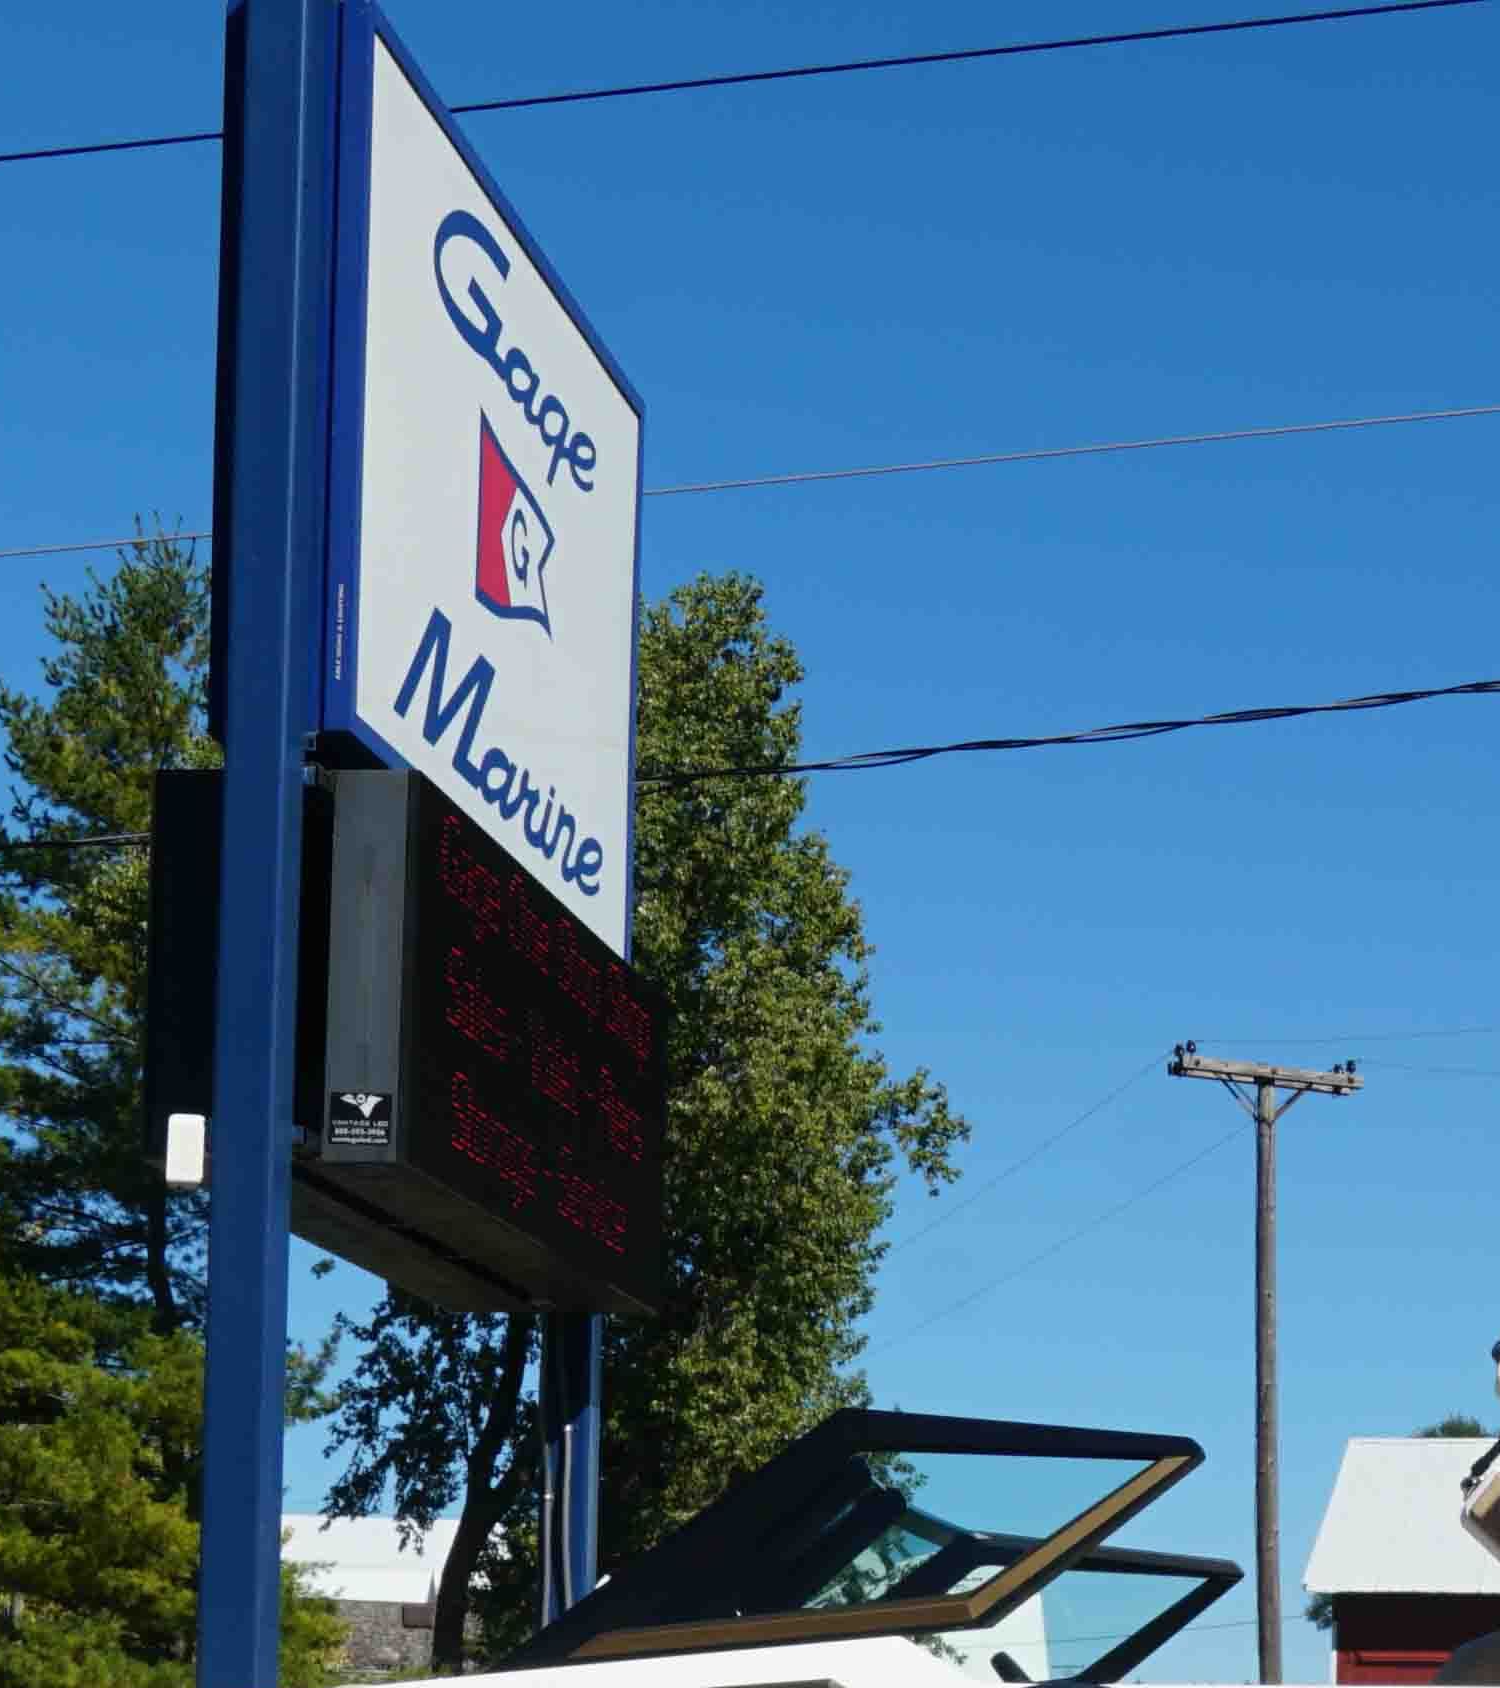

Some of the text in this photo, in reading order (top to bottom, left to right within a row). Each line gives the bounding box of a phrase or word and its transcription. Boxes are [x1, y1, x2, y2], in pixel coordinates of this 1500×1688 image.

[435, 209, 597, 493] Gage
[511, 508, 530, 591] G
[393, 608, 602, 897] Marine
